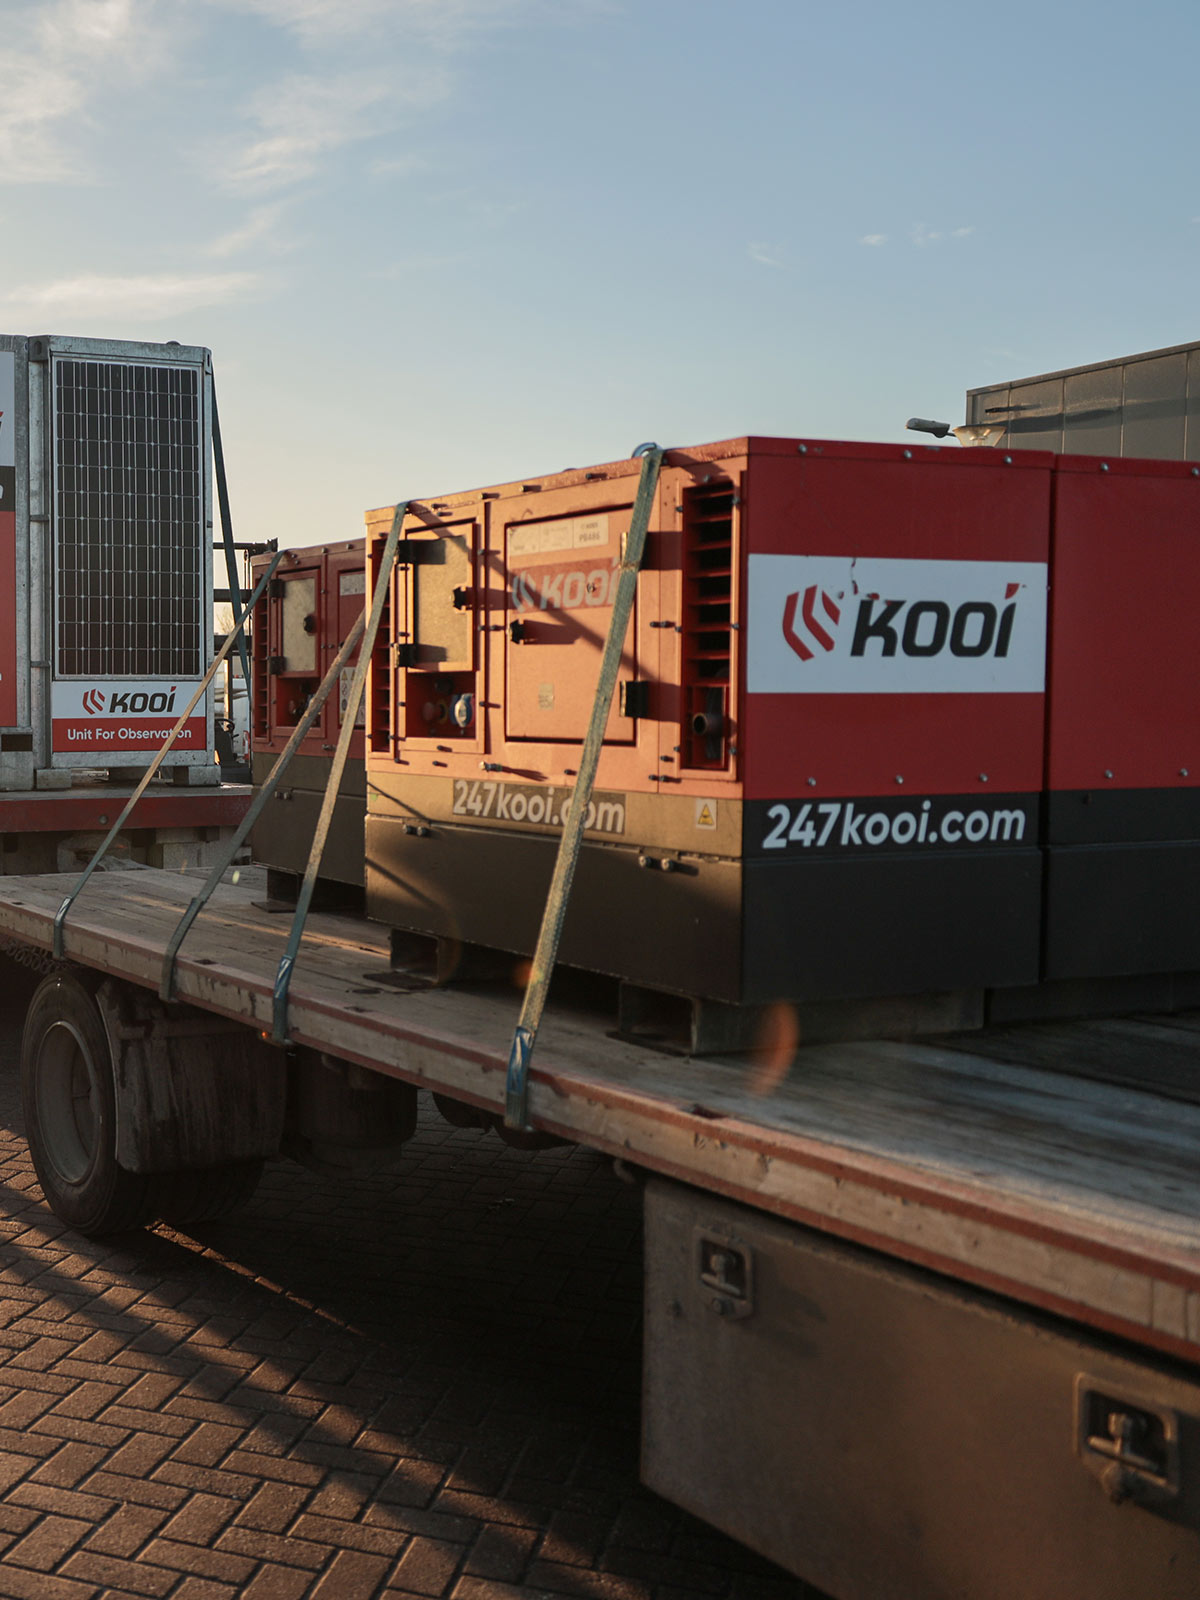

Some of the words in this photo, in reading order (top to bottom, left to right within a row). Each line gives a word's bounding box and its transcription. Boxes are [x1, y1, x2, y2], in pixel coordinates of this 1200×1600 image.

[67, 729, 92, 740] Unit
[95, 729, 115, 740] For
[118, 728, 192, 740] Observaton
[762, 800, 1026, 849] 247kooi.com
